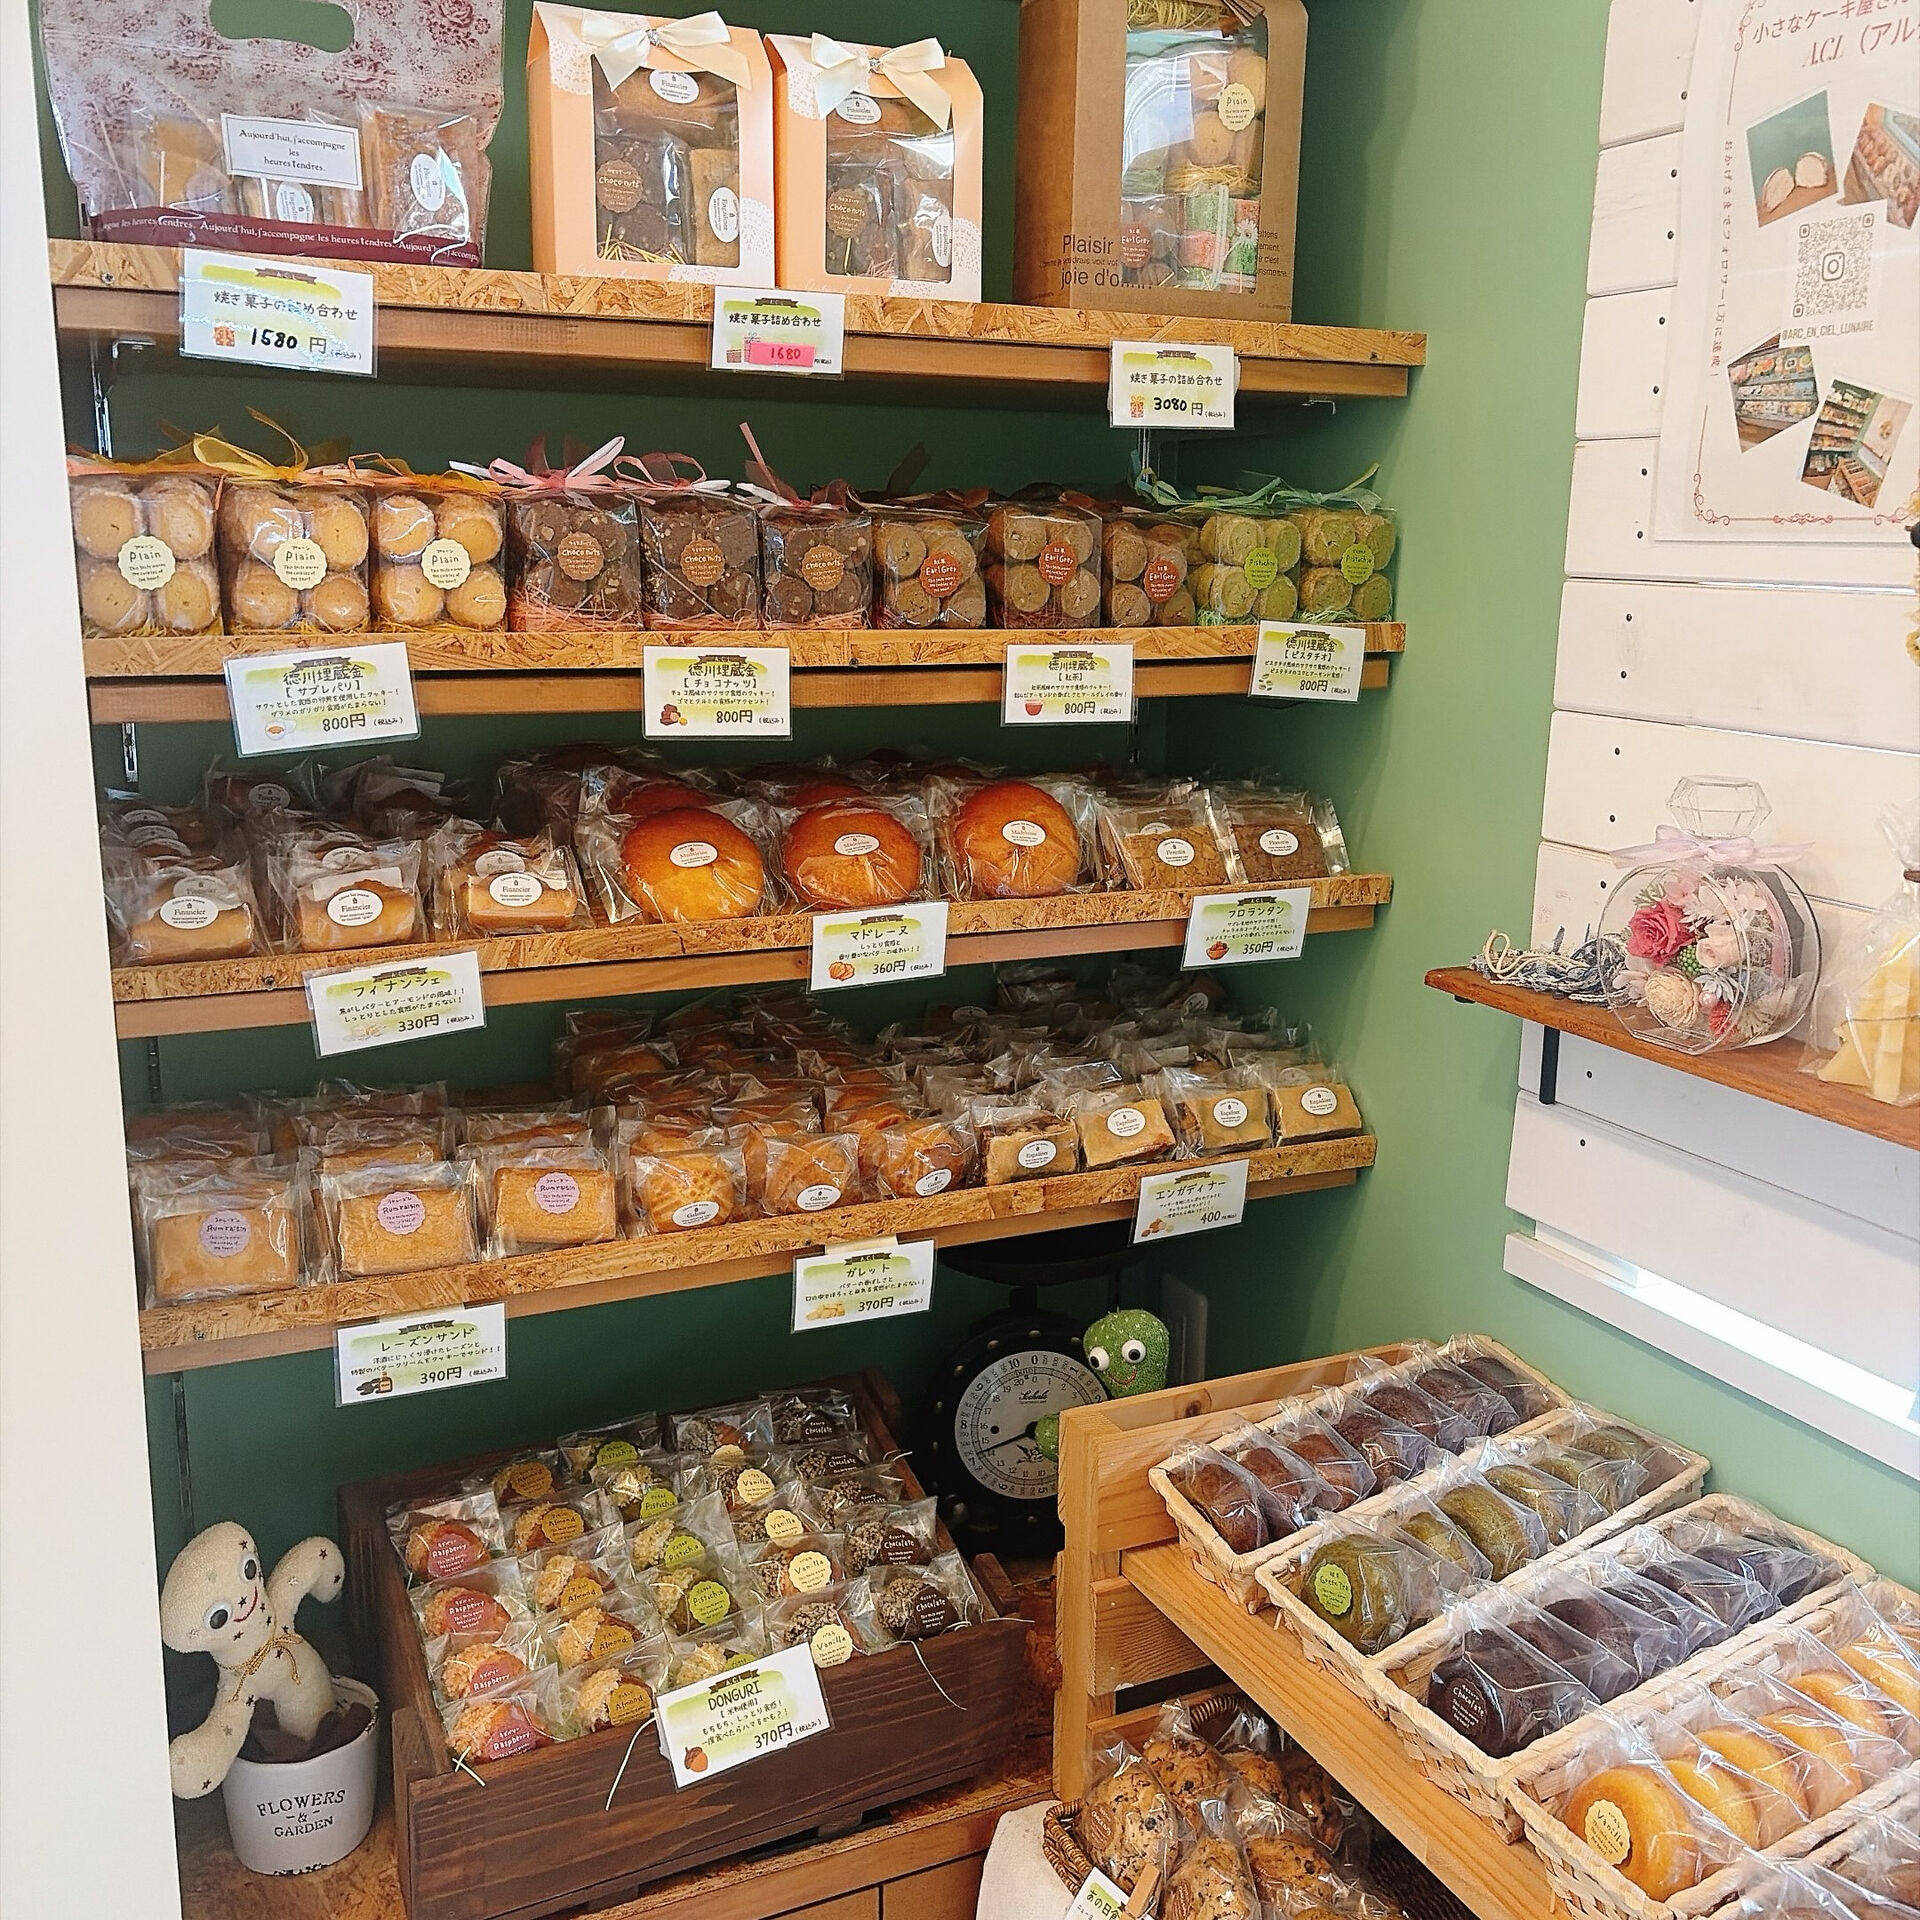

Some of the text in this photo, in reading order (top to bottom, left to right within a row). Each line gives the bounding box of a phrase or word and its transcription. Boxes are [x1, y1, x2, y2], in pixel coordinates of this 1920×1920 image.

[1861, 17, 1920, 54] (アル
[288, 149, 300, 157] les
[264, 156, 291, 169] heures
[200, 221, 257, 238] Aujourd'hui,
[317, 233, 330, 243] les
[331, 234, 360, 246] heures
[1062, 234, 1114, 255] Plaisir
[1061, 268, 1089, 289] joie
[729, 312, 822, 327] 焼き菓子詰め合わせ
[251, 328, 327, 354] 1580 円
[771, 348, 801, 360] 1680
[1130, 372, 1223, 386] 焼き菓子の詰め合わせ
[1153, 396, 1204, 416] 3080 円
[129, 551, 161, 563] Plain
[286, 551, 316, 562] Plain
[431, 554, 459, 565] Plain
[1284, 650, 1332, 661] 【ピスタチオ】
[688, 663, 758, 678] 徳川埋蔵金
[1048, 660, 1098, 671] 徳川埋蔵金
[283, 664, 365, 686] 徳川埋蔵金
[683, 677, 758, 688] 【チョコナッツ】
[1058, 672, 1083, 681] 【紅茶】
[285, 679, 361, 698] 【サブレパリ】
[1300, 680, 1328, 692] 800円
[1064, 701, 1096, 714] 800円
[323, 713, 366, 732] 800円
[716, 709, 753, 724] 800円
[502, 885, 531, 893] Financier
[174, 908, 206, 917] Financier
[341, 902, 371, 914] Financier
[1229, 906, 1284, 919] フロランタン
[850, 926, 909, 940] マドレーヌ
[1242, 941, 1274, 954] 350円
[872, 960, 906, 975] 360円
[353, 976, 441, 998] フィナンシェ
[398, 1014, 439, 1033] 330円
[1155, 1181, 1226, 1200] エンガディナー
[382, 1206, 398, 1214] Rum
[1200, 1210, 1221, 1224] 400
[846, 1264, 890, 1278] ガレット
[858, 1296, 894, 1312] 370円
[381, 1327, 475, 1352] レーズンサンド
[1009, 1358, 1020, 1369] 10
[1031, 1355, 1038, 1365] 0
[420, 1366, 463, 1385] 390円
[960, 1420, 967, 1429] 8
[742, 1478, 769, 1488] Vanilla
[770, 1518, 796, 1530] Vanilla
[794, 1559, 824, 1575] Vanilla
[448, 1600, 484, 1615] Raspberry
[916, 1598, 946, 1612] Chocolate
[816, 1636, 847, 1651] Vanilla
[473, 1673, 510, 1691] Raspberry
[707, 1680, 763, 1712] DONGURI
[1453, 1687, 1485, 1717] Chocolate
[719, 1698, 759, 1718] 【米粉使用】
[493, 1732, 530, 1751] Raspberry
[754, 1721, 793, 1749] 370円
[256, 1789, 346, 1817] FLOWERS
[274, 1815, 333, 1837] GARDEN
[1597, 1809, 1624, 1848] Vanilla
